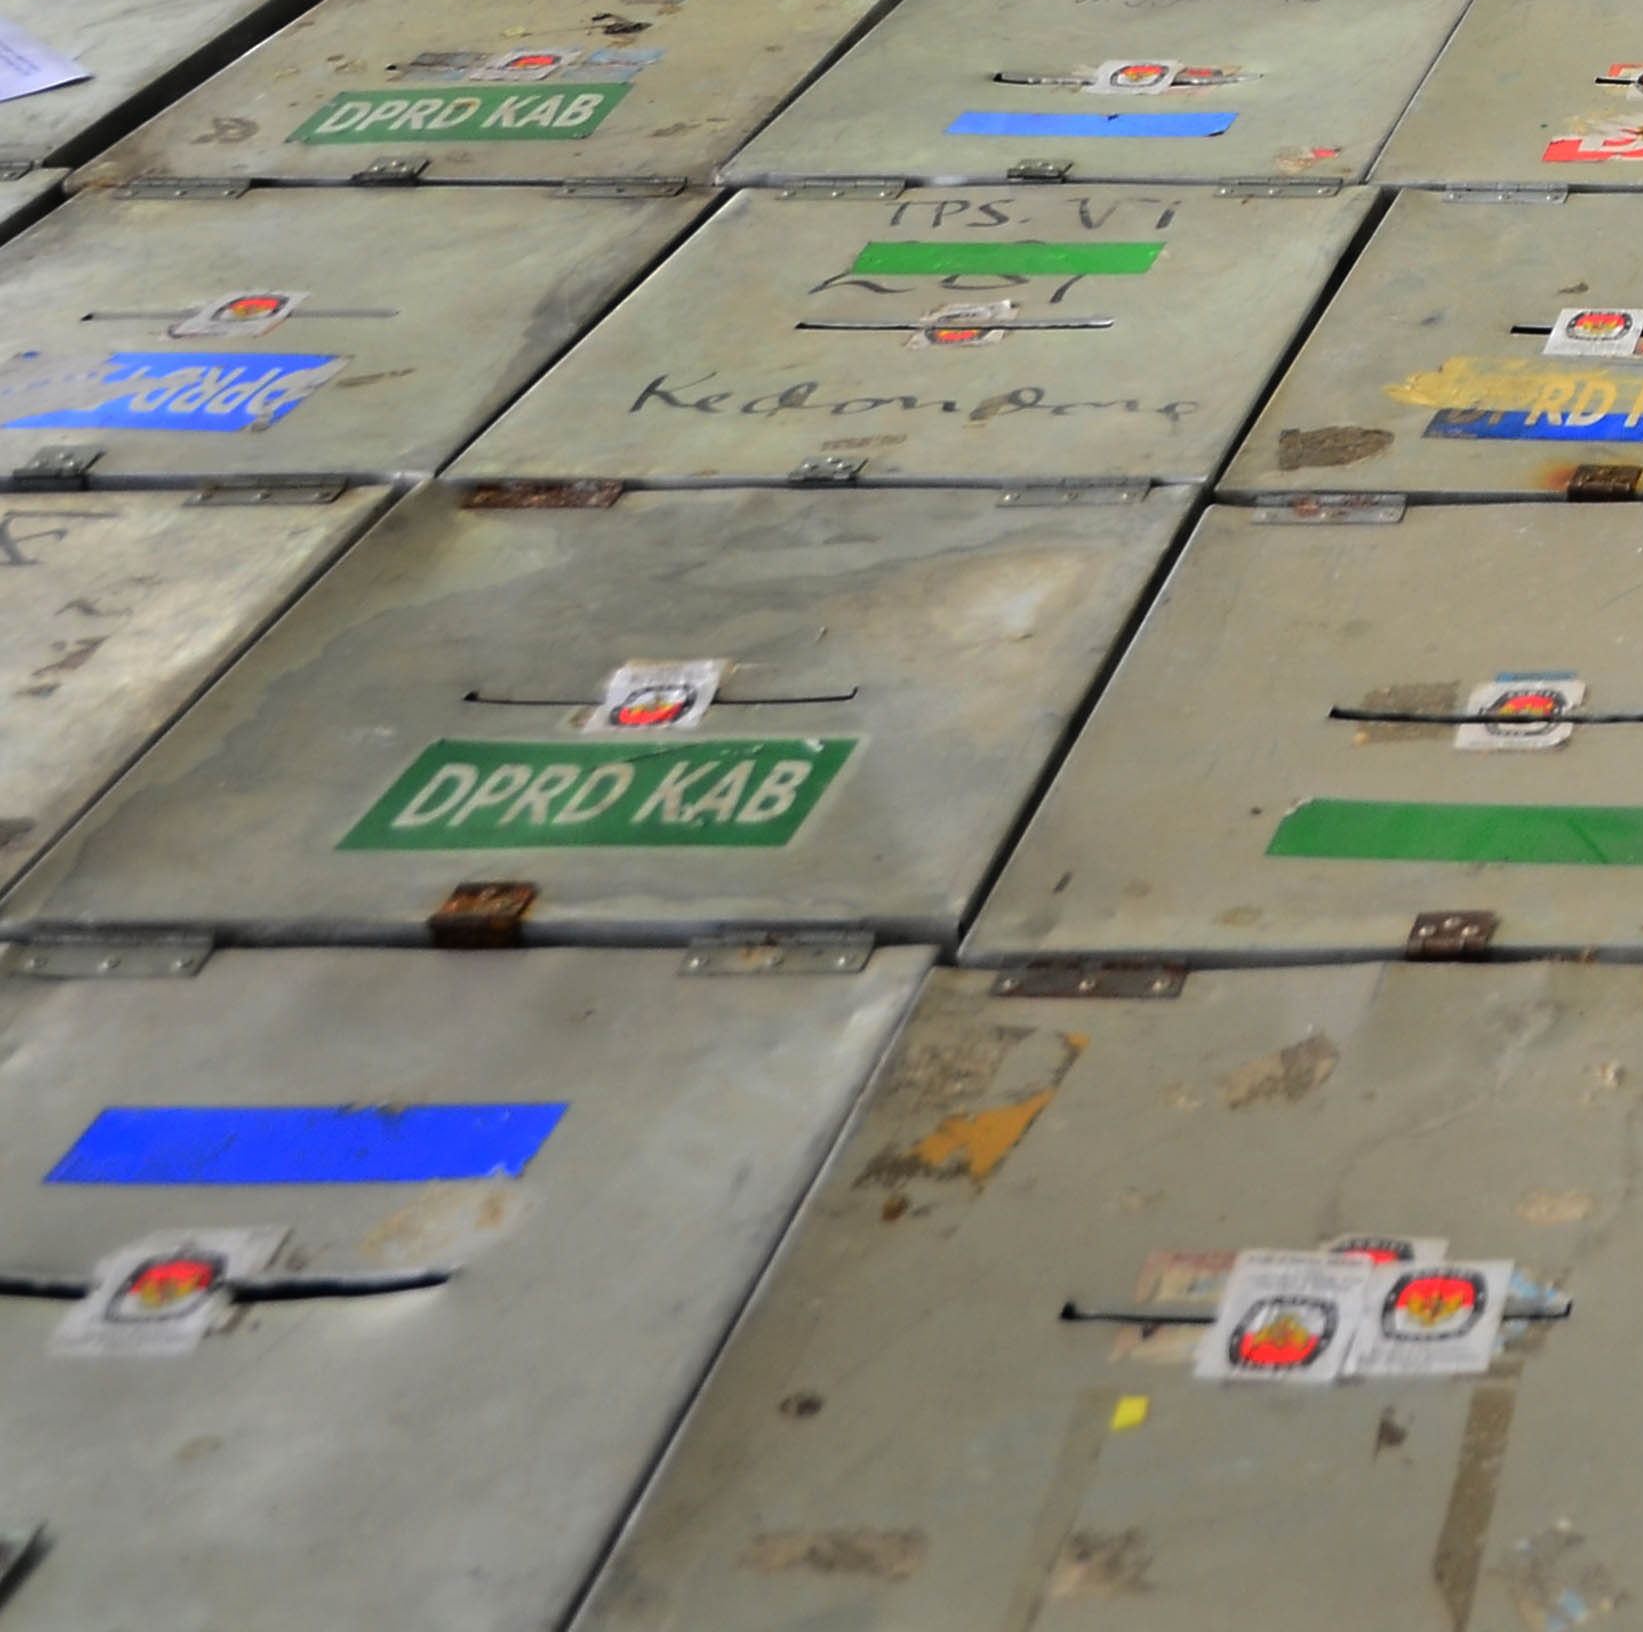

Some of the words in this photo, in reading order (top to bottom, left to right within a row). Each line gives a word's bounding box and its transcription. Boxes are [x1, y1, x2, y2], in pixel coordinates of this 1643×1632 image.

[314, 93, 487, 135] DPRD
[484, 89, 608, 132] KAB
[389, 762, 638, 829] DPRD
[628, 759, 814, 827] KAB
